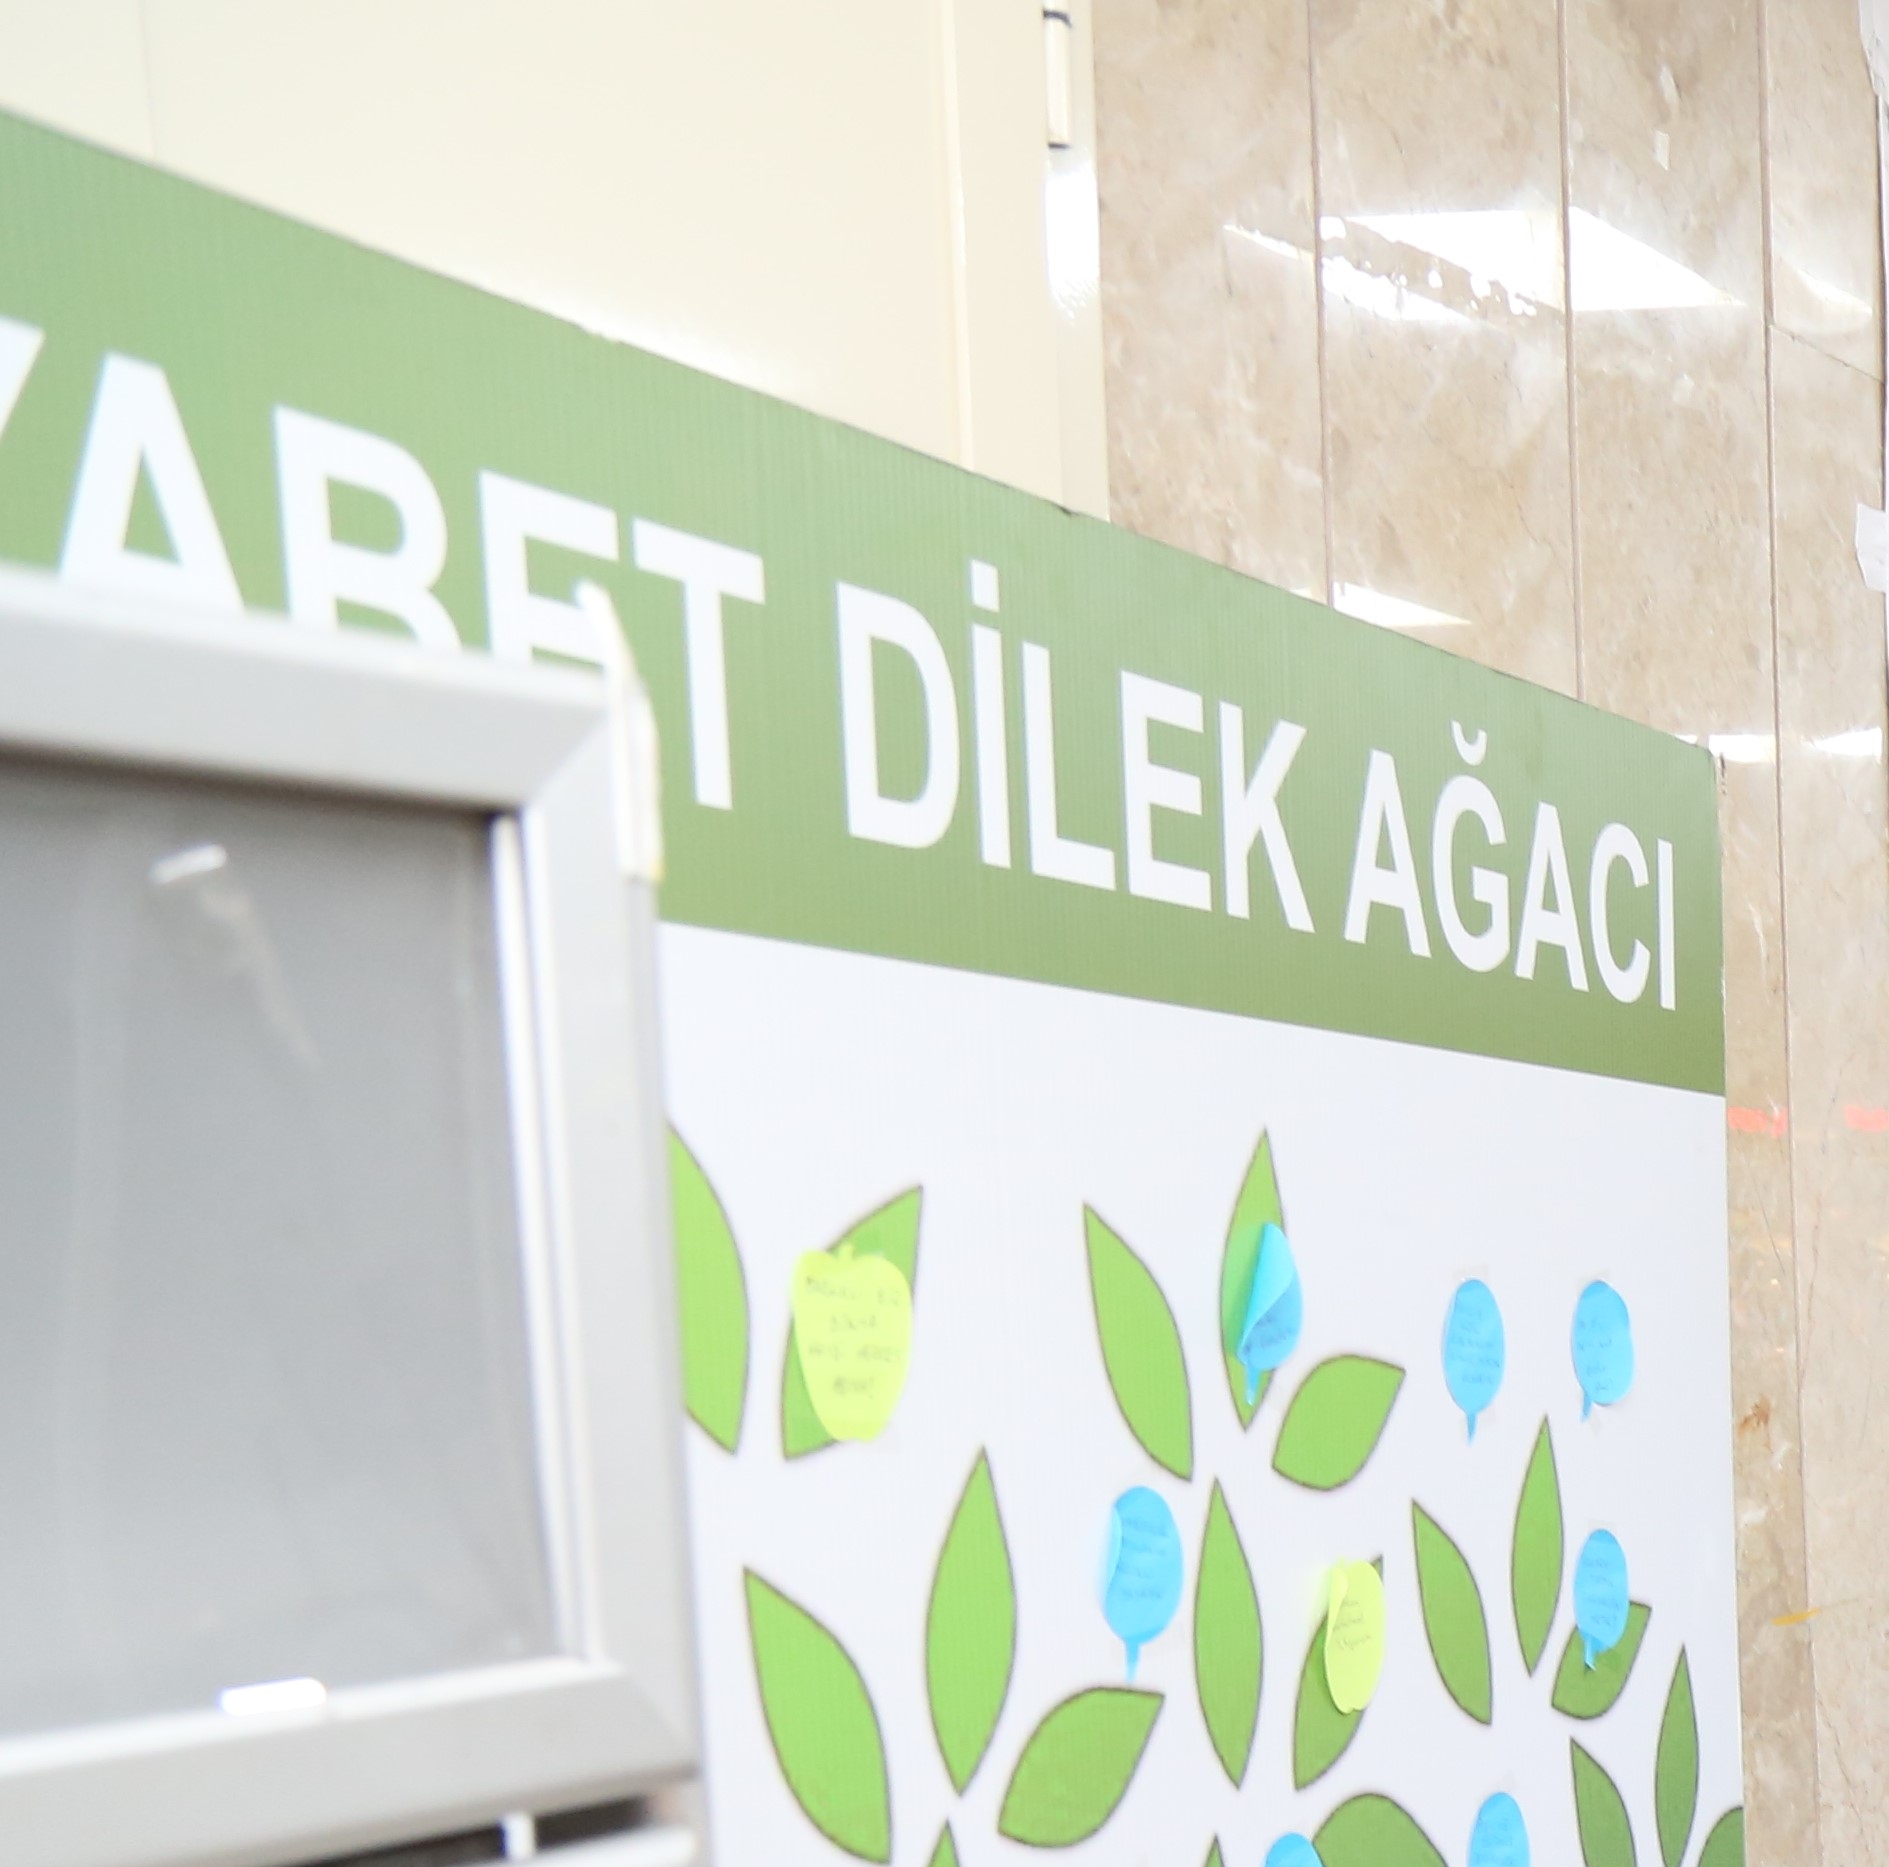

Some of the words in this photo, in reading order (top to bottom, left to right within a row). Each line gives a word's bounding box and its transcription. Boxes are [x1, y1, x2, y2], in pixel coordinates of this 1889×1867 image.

[0, 316, 766, 810] ABET
[836, 558, 1315, 935] DİLEK
[1344, 720, 1677, 1011] AĞACI
